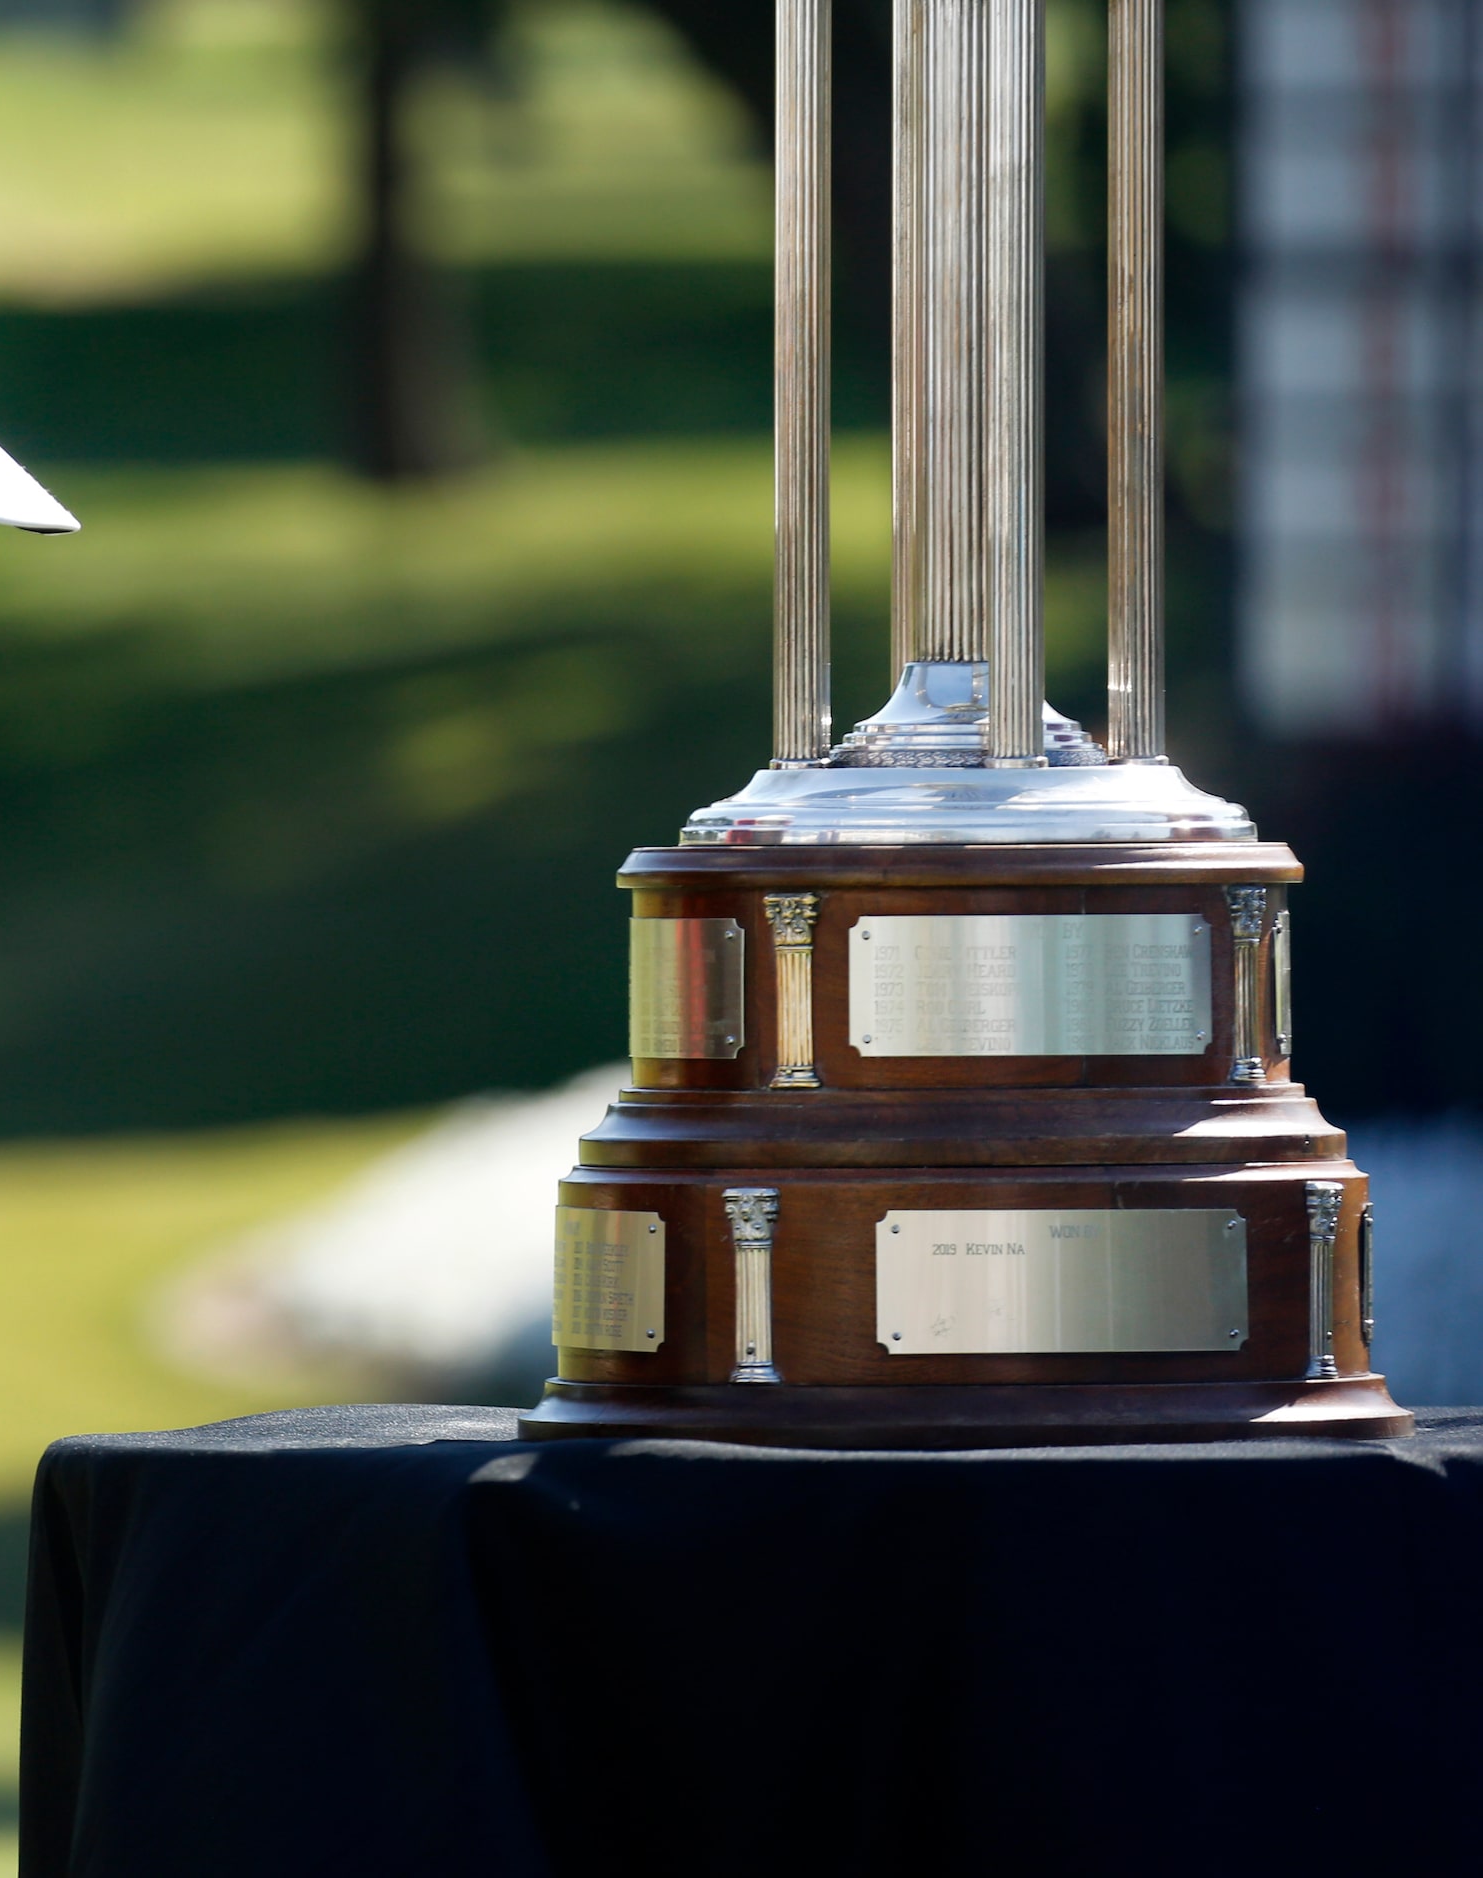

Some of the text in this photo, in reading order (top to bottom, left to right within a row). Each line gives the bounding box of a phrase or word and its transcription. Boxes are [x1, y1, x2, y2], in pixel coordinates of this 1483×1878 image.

[874, 945, 901, 961] 1971
[957, 945, 1017, 960] ITTLER
[874, 963, 904, 979] 1972
[967, 963, 1016, 978] HEARD
[1067, 962, 1095, 978] 197
[874, 982, 904, 997] 1973
[951, 982, 1021, 997] EISKOPF
[874, 1000, 905, 1016] 1974
[947, 1036, 1011, 1051] TEVINO
[1049, 1224, 1080, 1239] WON
[932, 1242, 1026, 1256] 2019 KEVIN NA
